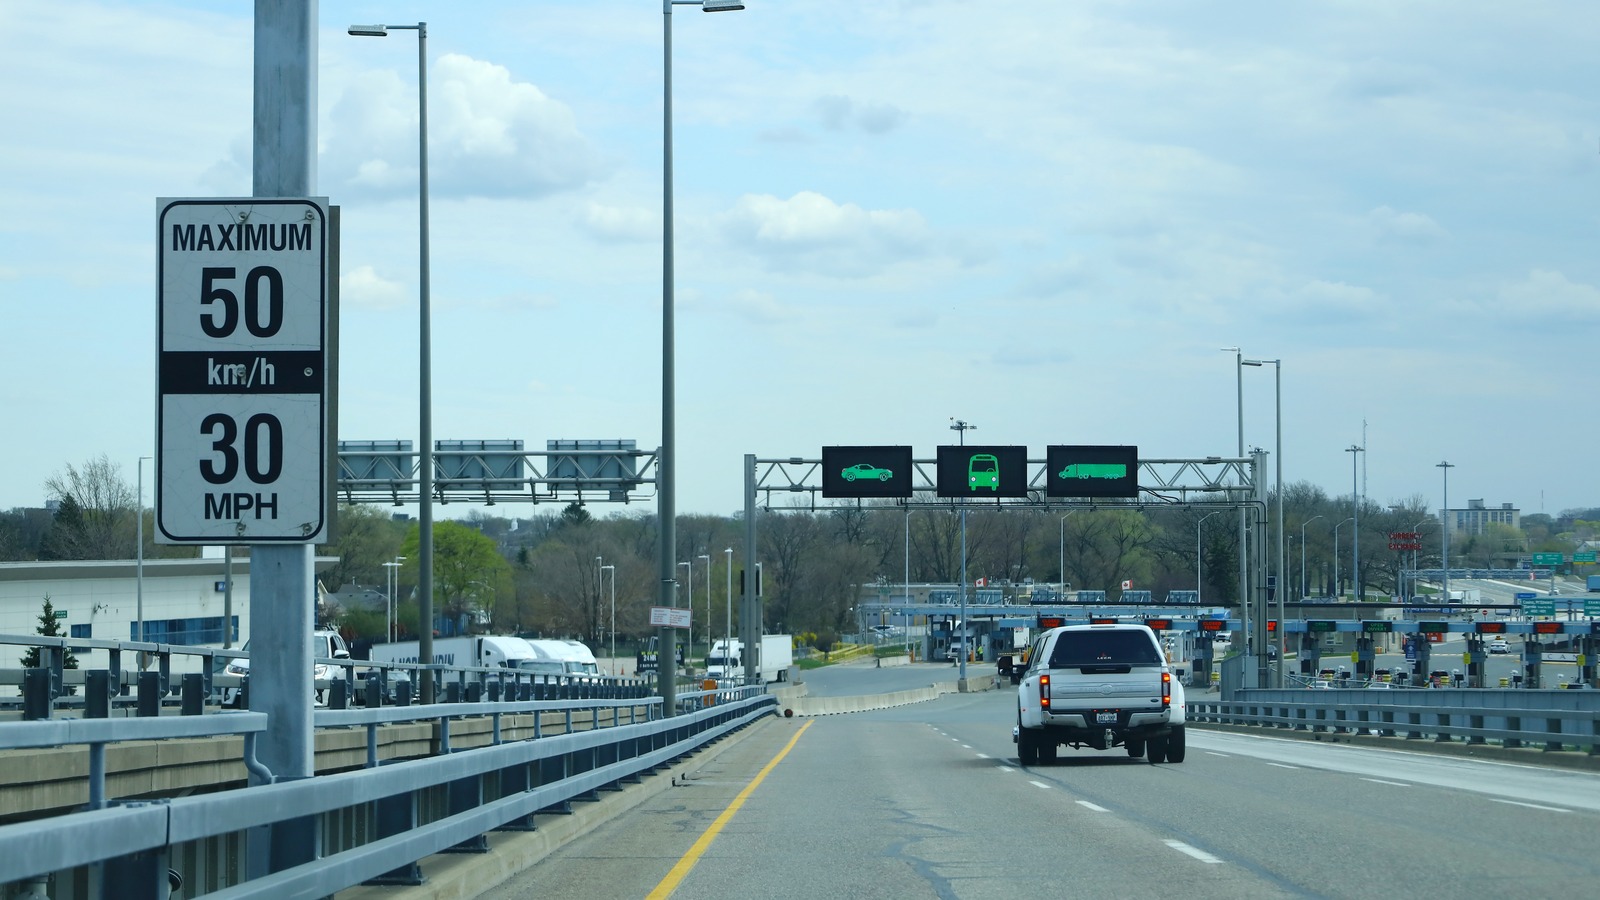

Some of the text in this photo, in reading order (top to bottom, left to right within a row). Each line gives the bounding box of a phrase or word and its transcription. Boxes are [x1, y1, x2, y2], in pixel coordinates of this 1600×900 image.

[172, 223, 312, 252] MAXIMUM
[199, 265, 284, 338] 50
[207, 357, 275, 388] km/h
[199, 412, 283, 485] 30
[204, 492, 278, 520] MPH
[1389, 532, 1422, 540] CURRENCY
[1389, 542, 1422, 550] EXCHANGE
